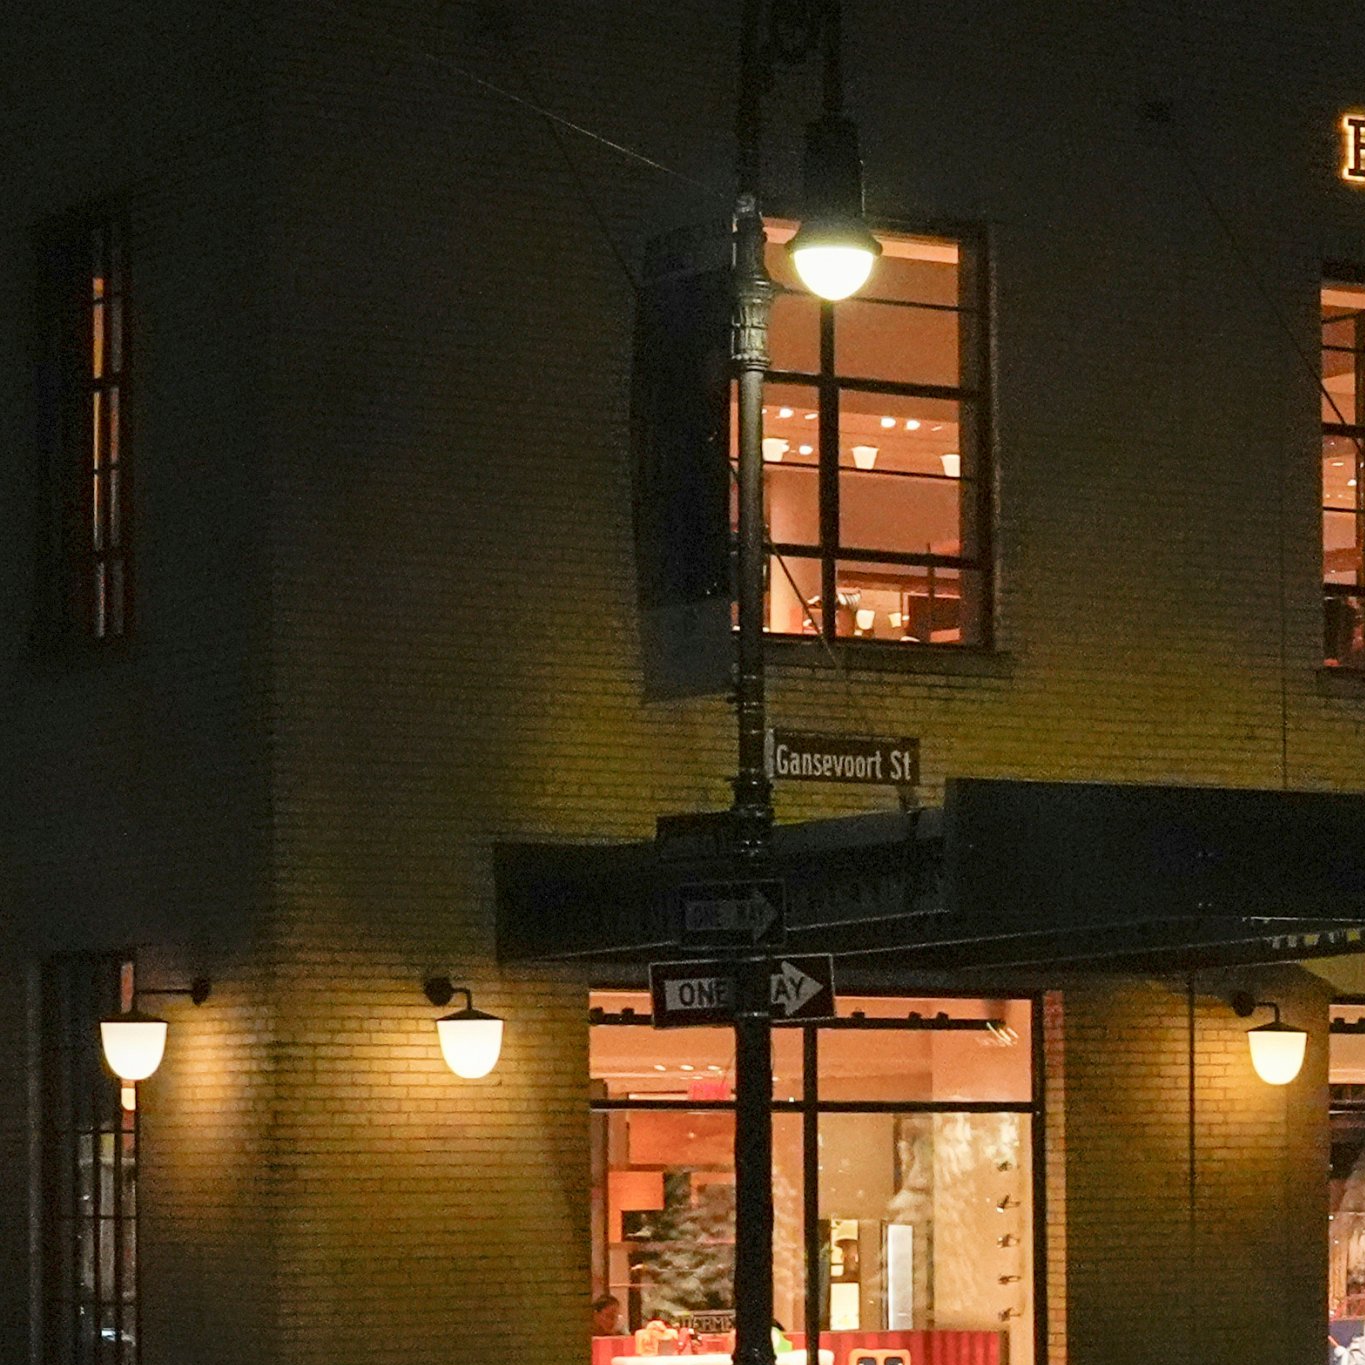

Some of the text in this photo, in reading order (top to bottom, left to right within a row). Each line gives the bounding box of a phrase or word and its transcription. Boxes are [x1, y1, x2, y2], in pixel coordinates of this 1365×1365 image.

[776, 743, 912, 781] Gansevoort St
[678, 975, 805, 1007] ONE AY
